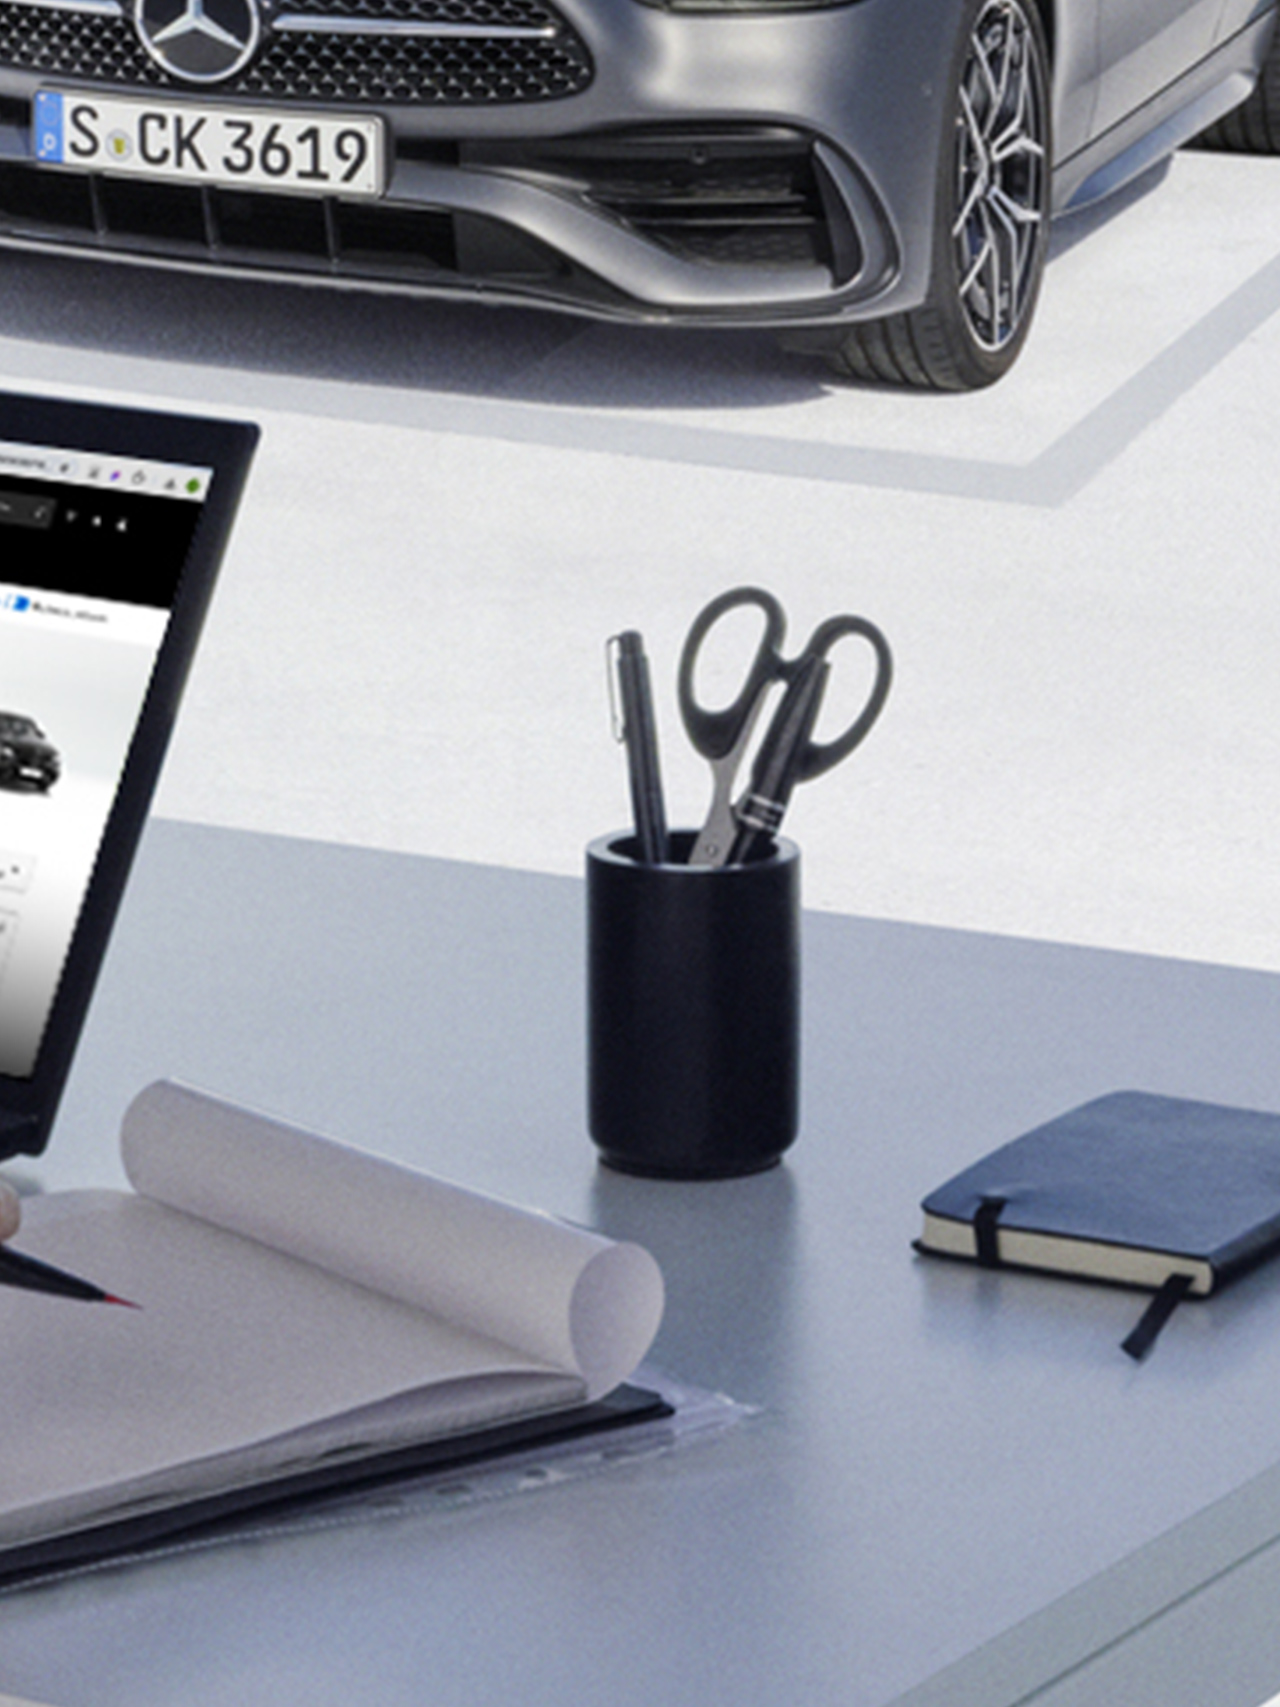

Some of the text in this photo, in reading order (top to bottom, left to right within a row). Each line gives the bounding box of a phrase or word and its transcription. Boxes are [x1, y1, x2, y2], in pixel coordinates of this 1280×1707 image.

[70, 106, 366, 182] S CK 3619
